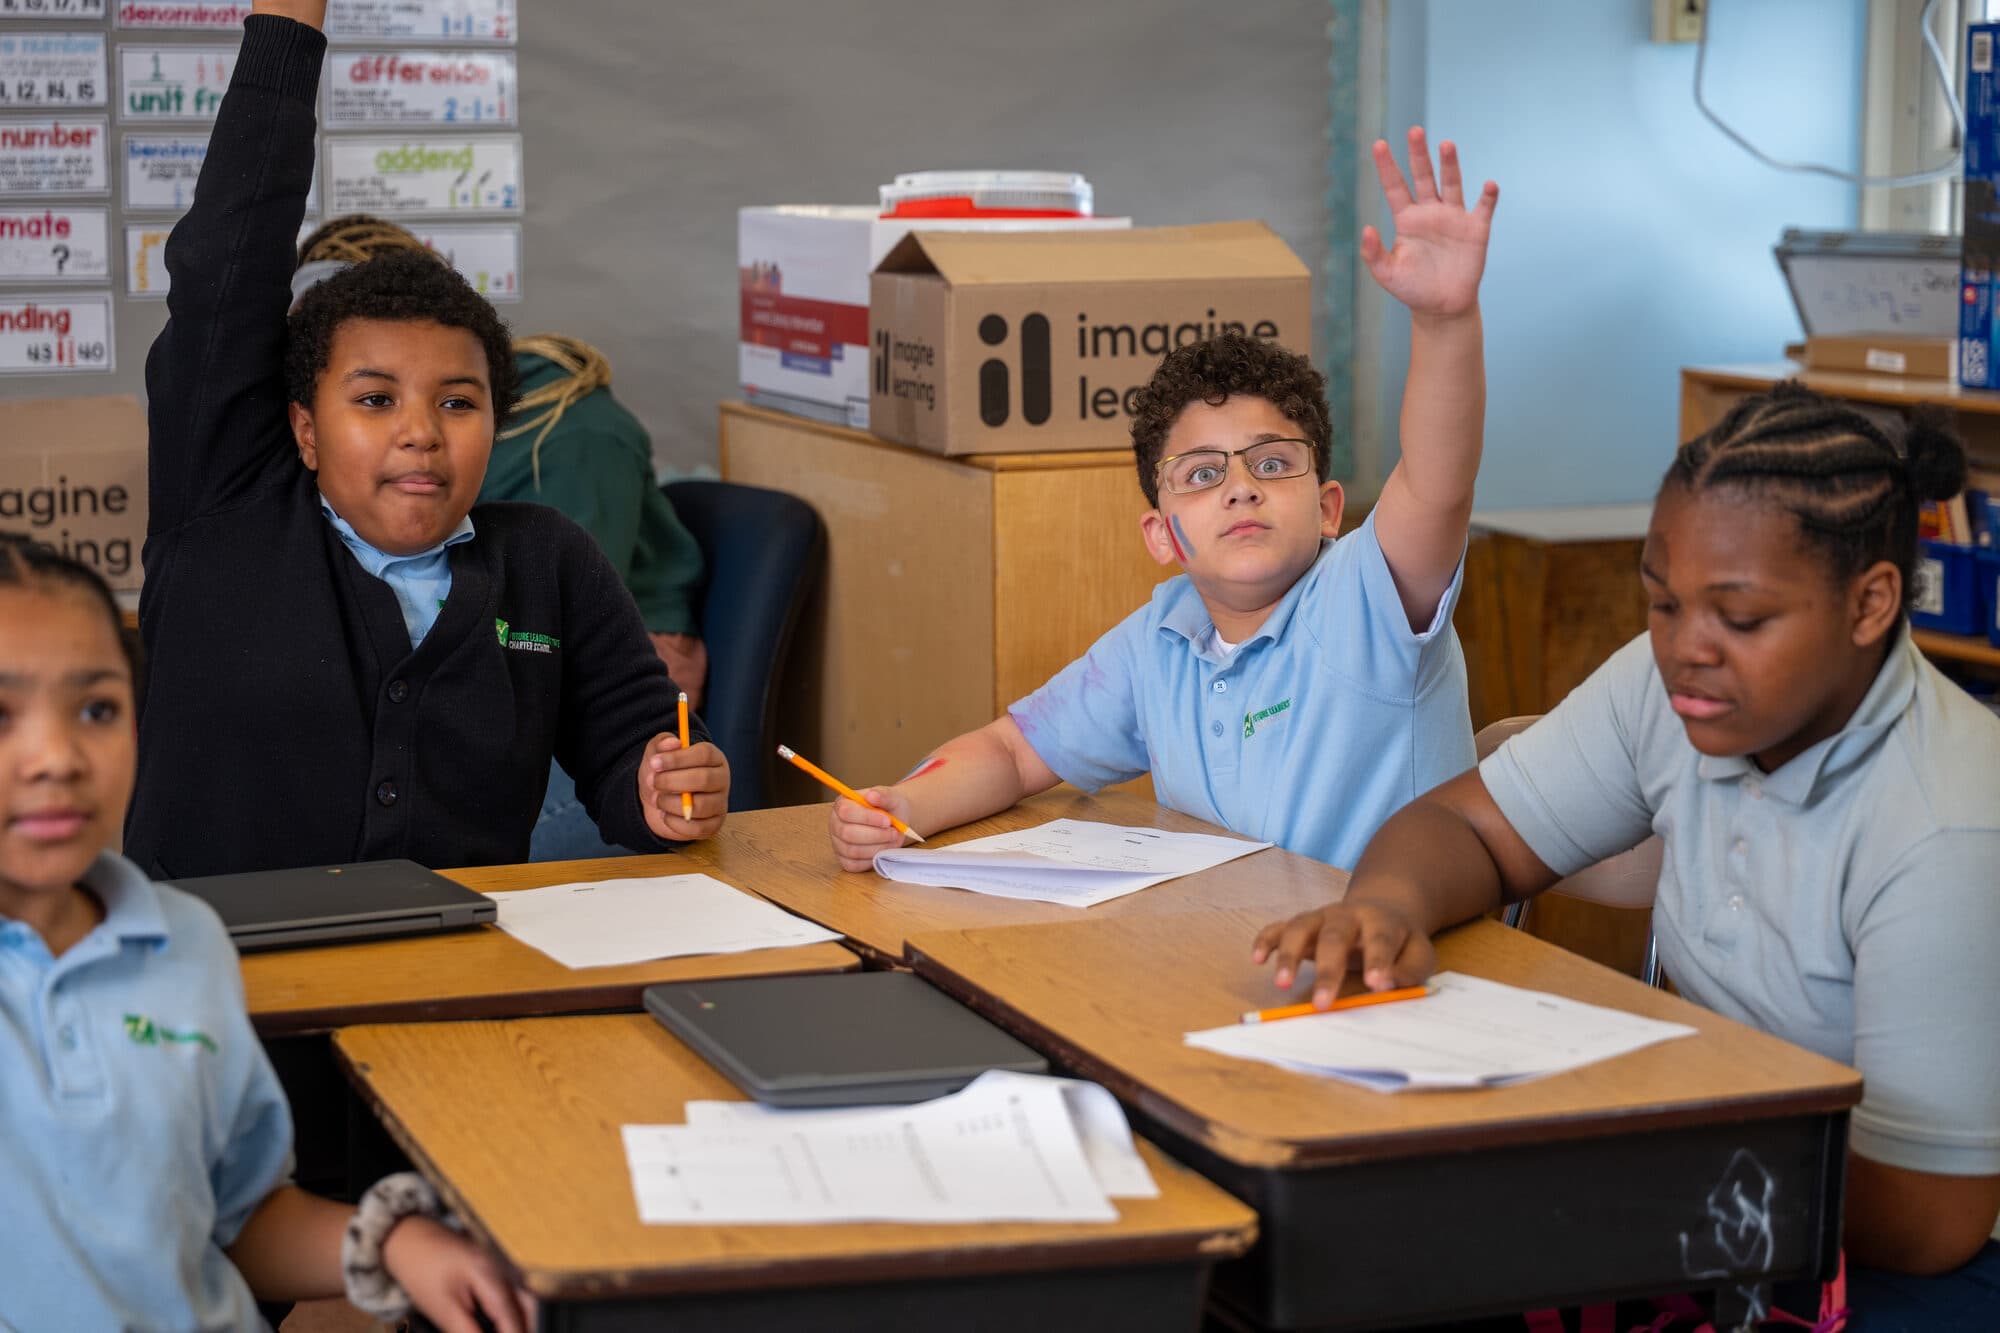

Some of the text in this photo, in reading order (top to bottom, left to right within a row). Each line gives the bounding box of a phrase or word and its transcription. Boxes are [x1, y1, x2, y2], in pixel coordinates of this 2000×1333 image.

[130, 84, 184, 112] unit
[2, 121, 97, 149] number
[374, 144, 474, 174] addend
[0, 210, 71, 238] mate
[0, 475, 129, 528] agine
[508, 640, 533, 651] CHARTER
